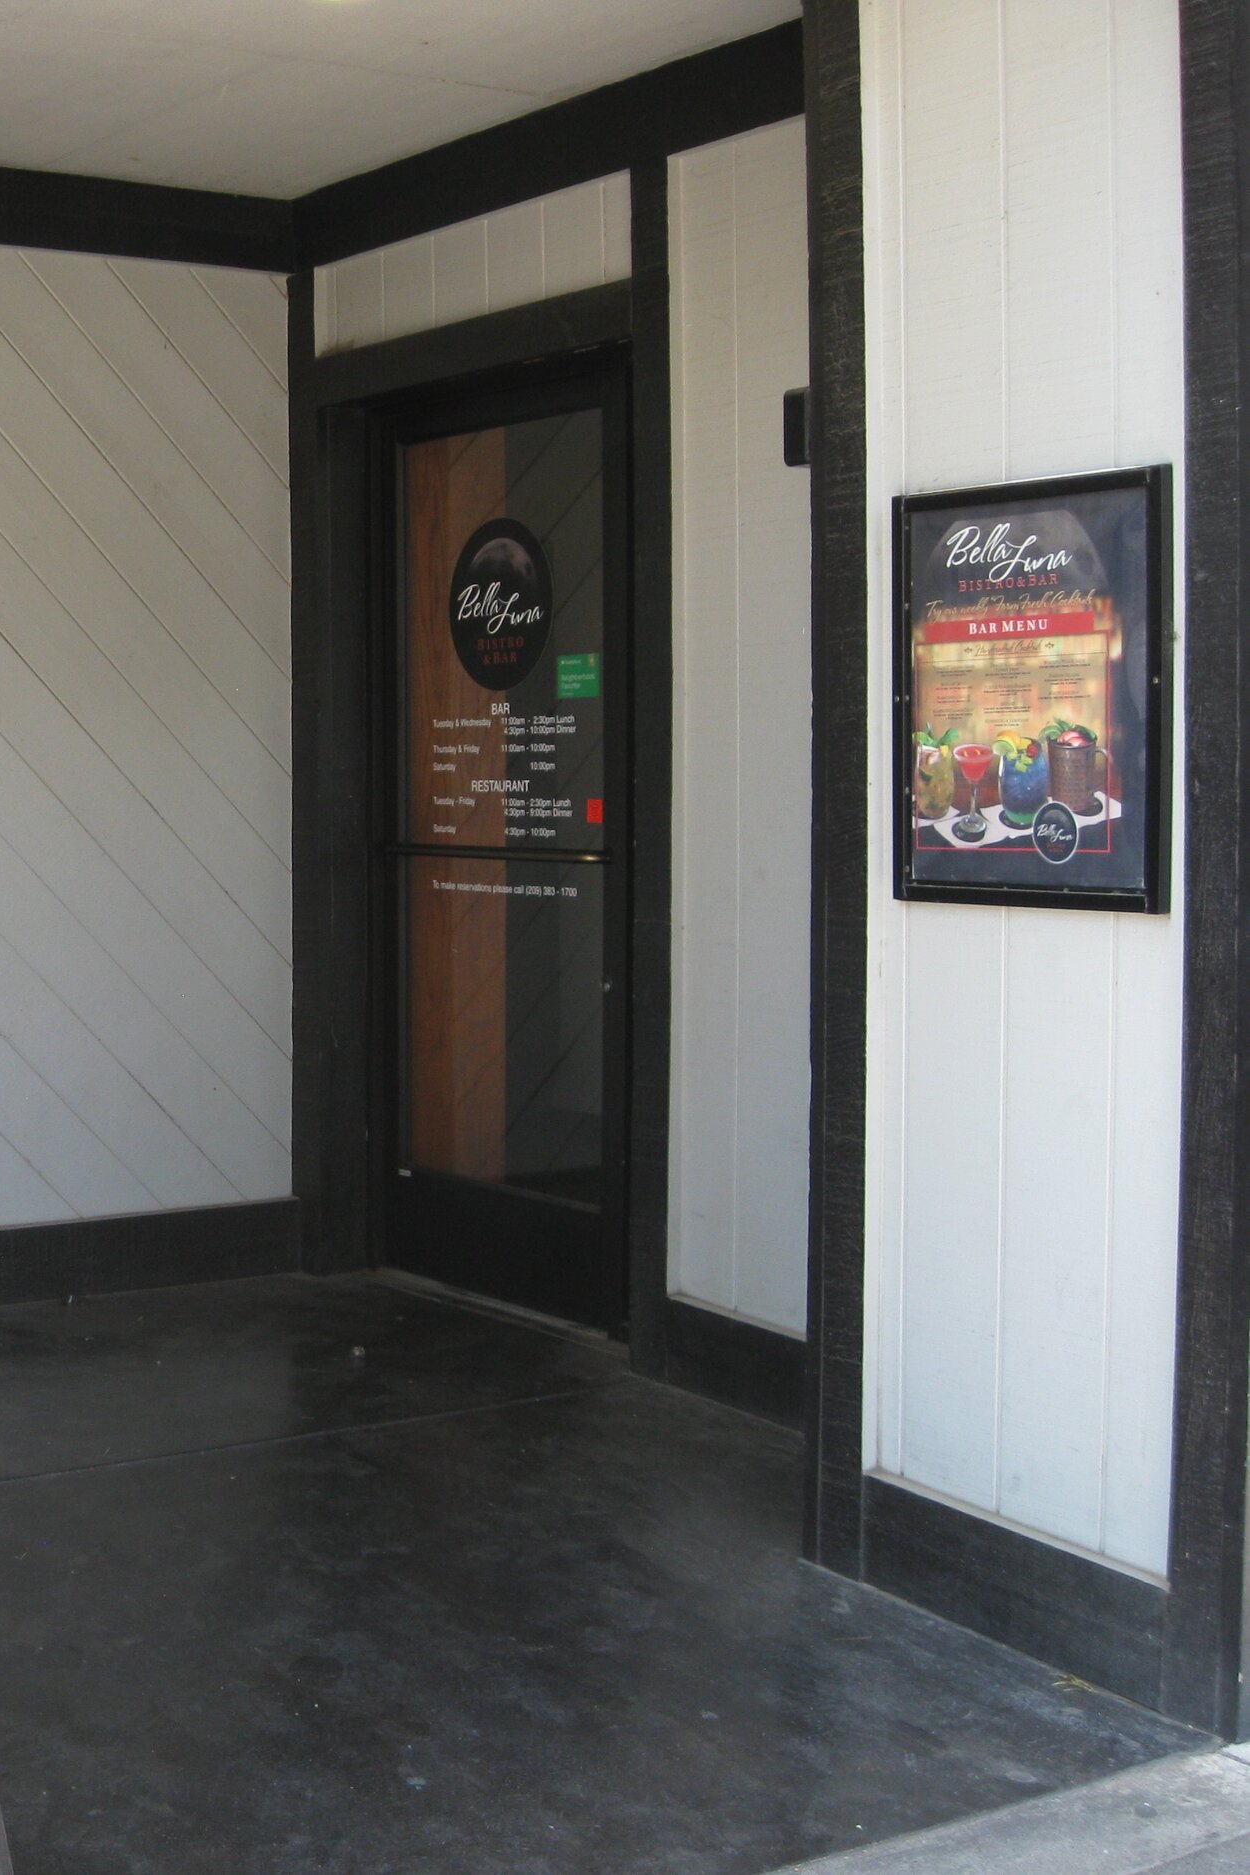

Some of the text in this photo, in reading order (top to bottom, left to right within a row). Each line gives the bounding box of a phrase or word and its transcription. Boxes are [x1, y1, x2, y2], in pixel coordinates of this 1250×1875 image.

[946, 522, 1073, 583] Bella Luna
[457, 581, 544, 634] Bella Luna
[968, 618, 1049, 635] BAR MENU
[477, 635, 526, 651] BISTRO
[491, 702, 511, 716] BAR
[533, 715, 555, 725] 2:30pm
[556, 714, 575, 724] Lunch
[504, 726, 526, 736] 4:30pm
[530, 725, 555, 736] 10:00pm
[556, 724, 577, 734] Dinner
[530, 743, 556, 754] 10:00pm
[530, 761, 556, 772] 10:00pm
[471, 780, 530, 793] RESTAURANT
[530, 798, 551, 808] 2:30pm
[553, 799, 572, 808] Lunch
[504, 808, 526, 818] 4:30pm
[530, 808, 551, 819] 9:00pm
[553, 808, 573, 818] Dinner
[504, 827, 526, 837] 4:30pm
[531, 827, 556, 838] 10:00pm
[441, 881, 456, 891] make
[457, 883, 492, 893] reservations
[493, 884, 512, 894] please
[514, 885, 524, 895] call
